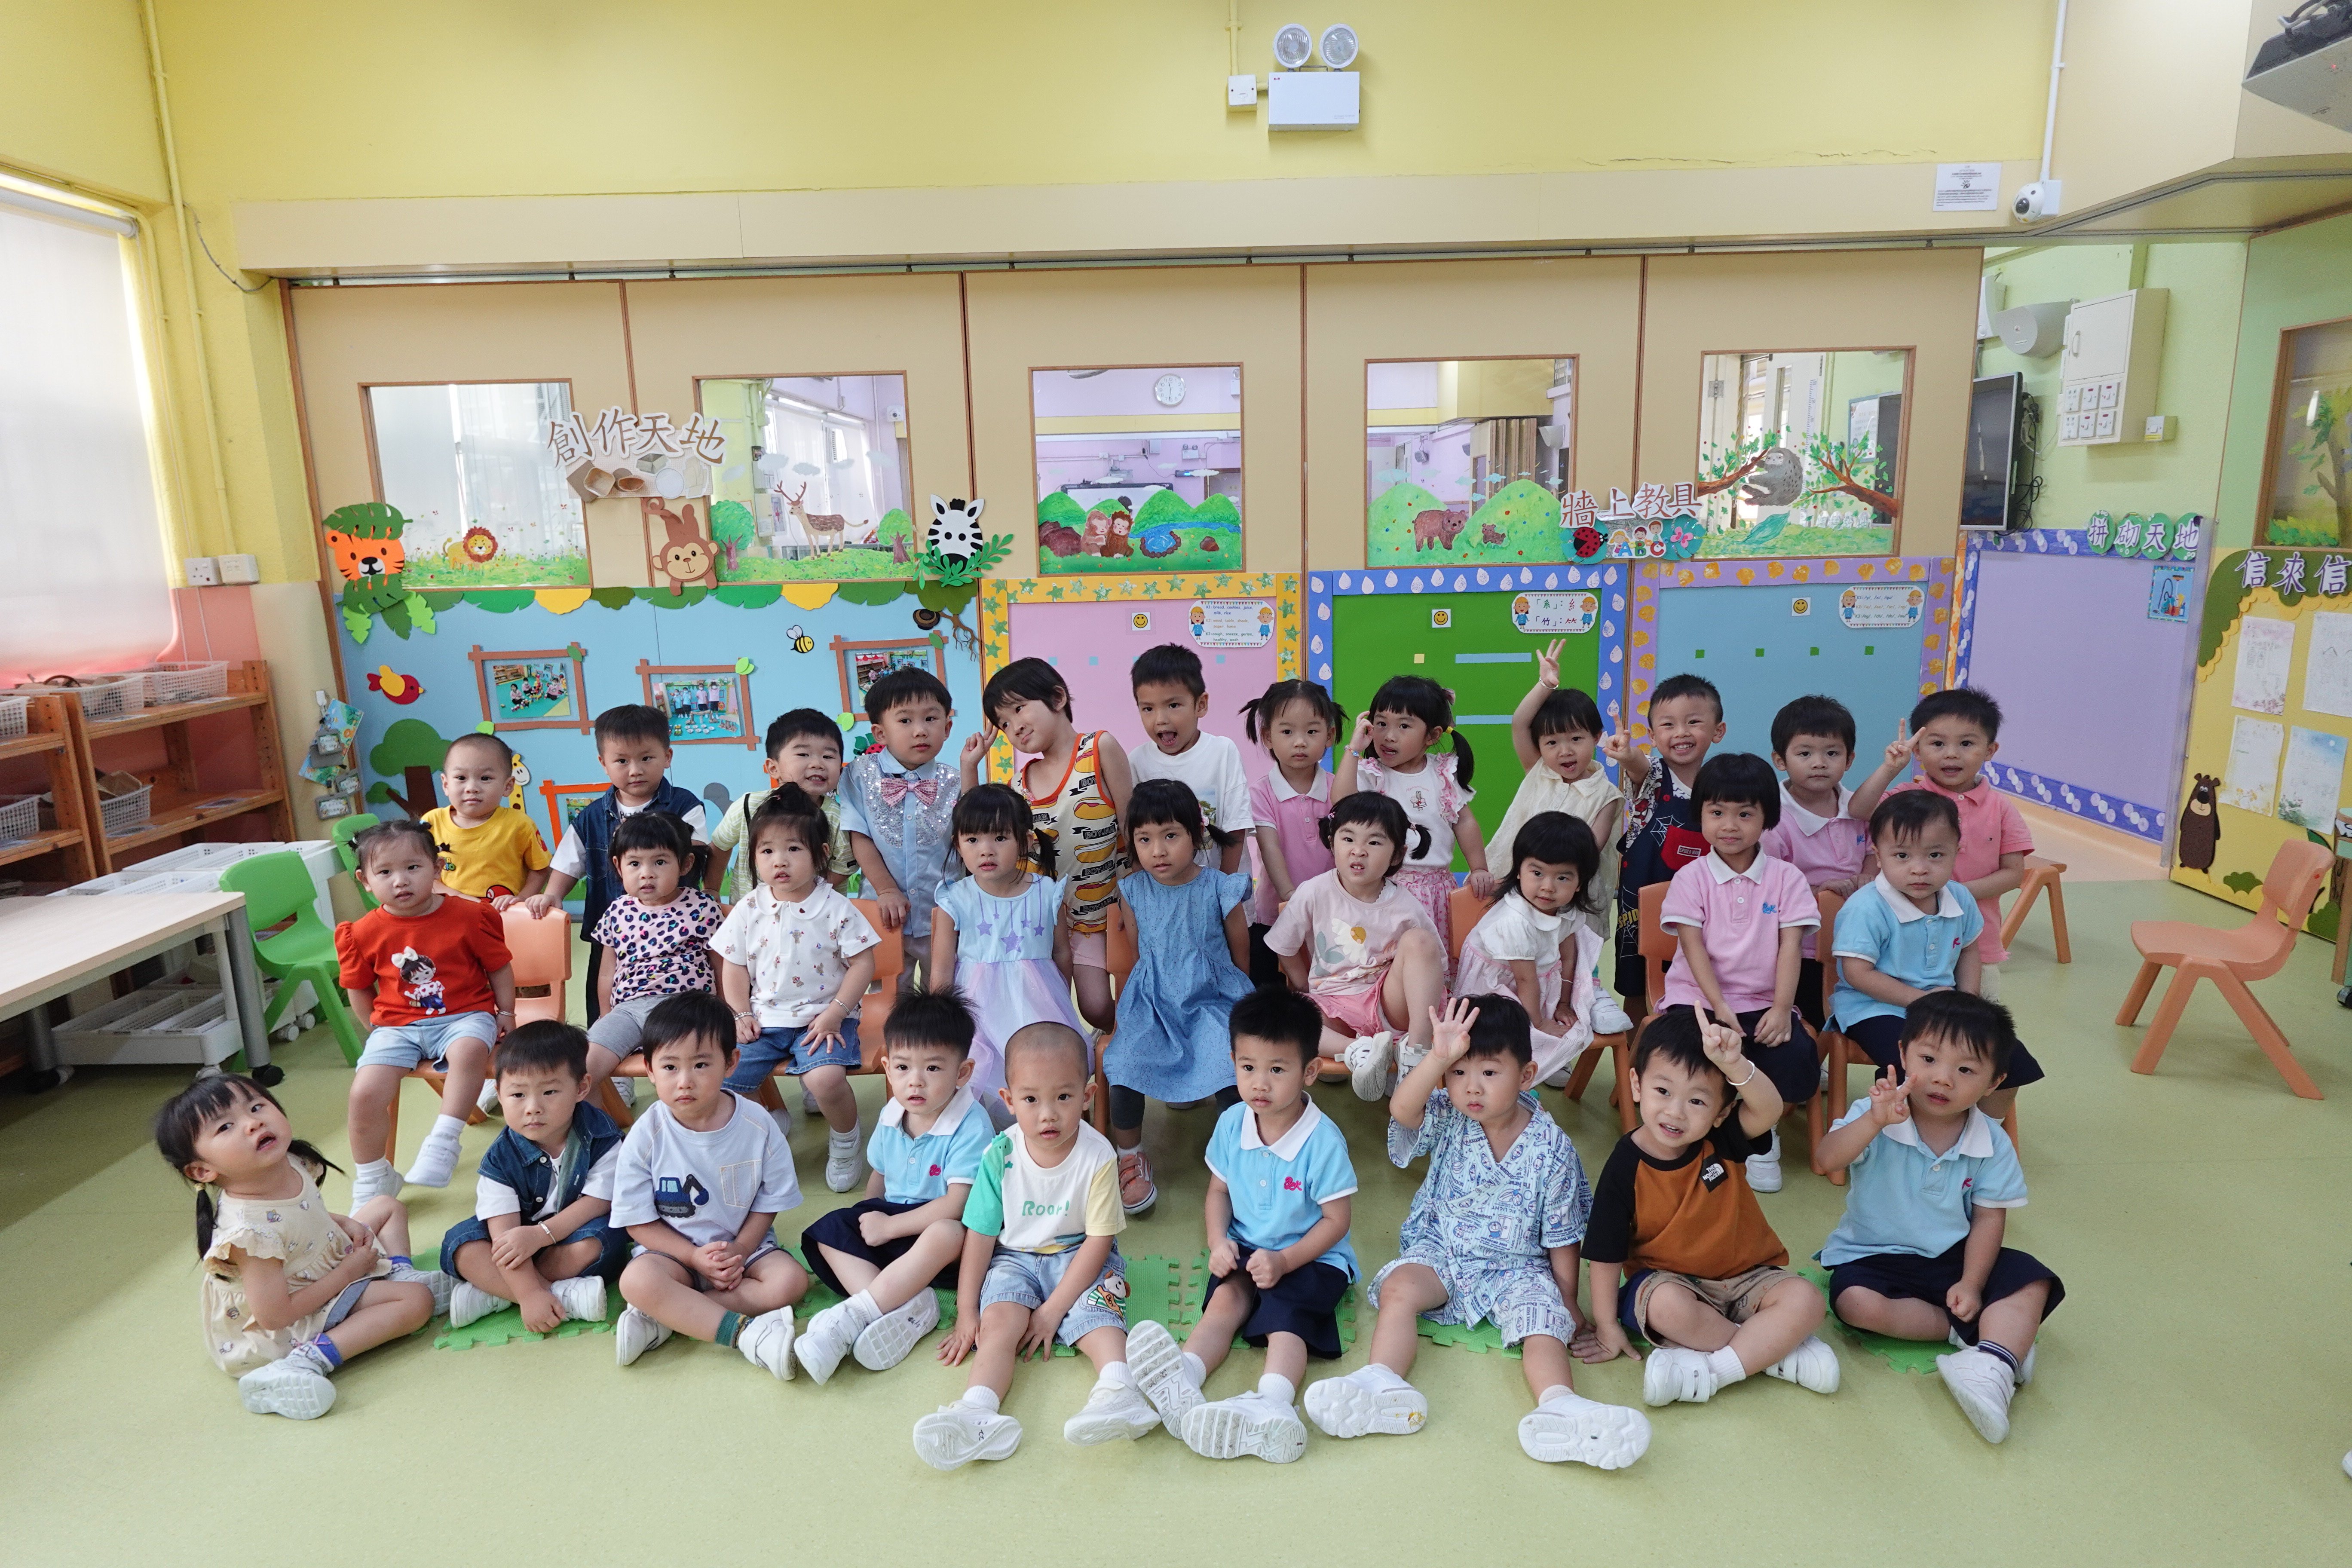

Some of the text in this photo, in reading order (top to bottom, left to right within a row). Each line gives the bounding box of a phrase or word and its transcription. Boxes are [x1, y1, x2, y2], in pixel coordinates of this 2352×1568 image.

[549, 408, 725, 468] 創作天地
[1562, 483, 1703, 527] 牆上教具
[2088, 517, 2199, 551] 拼砌天地
[2235, 551, 2352, 595] 信來信
[1085, 826, 1115, 839] BOYJAM
[1084, 861, 1113, 876] BOYJAM
[1082, 897, 1112, 912] BOYJAM
[1702, 1170, 1717, 1181] NORTH
[1706, 1164, 1715, 1173] THE
[1709, 1173, 1719, 1182] FACE
[1022, 1200, 1070, 1217] Roar!
